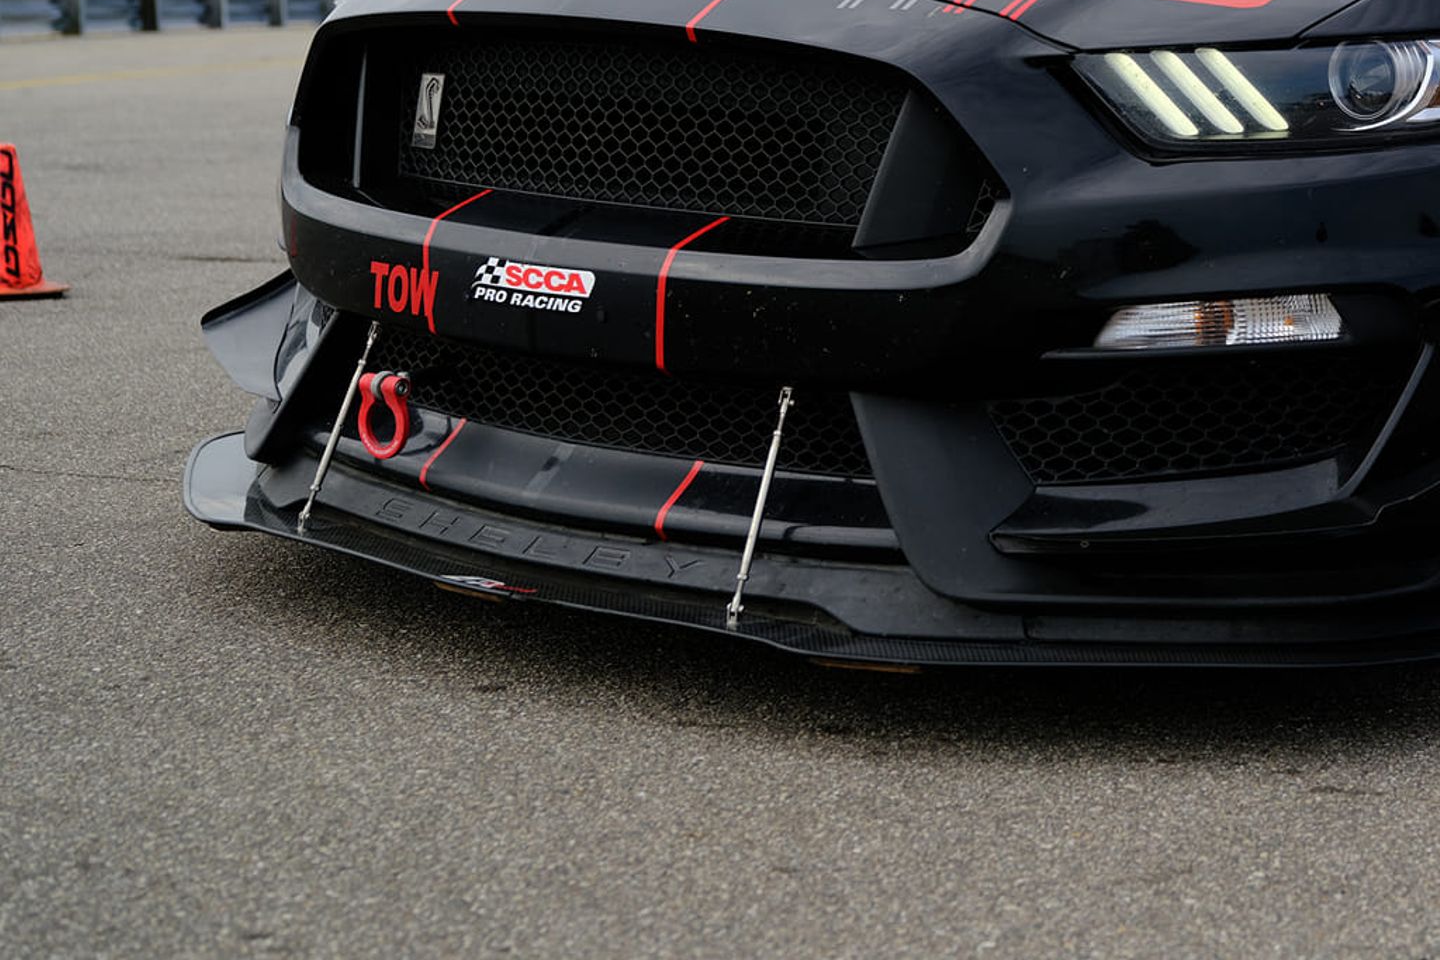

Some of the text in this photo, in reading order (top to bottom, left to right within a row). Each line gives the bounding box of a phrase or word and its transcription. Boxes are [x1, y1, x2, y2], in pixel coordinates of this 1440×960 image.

[370, 261, 440, 318] TOW
[474, 286, 583, 313] PRO RACING
[505, 265, 588, 295] SCCA
[376, 496, 703, 580] SHELBY
